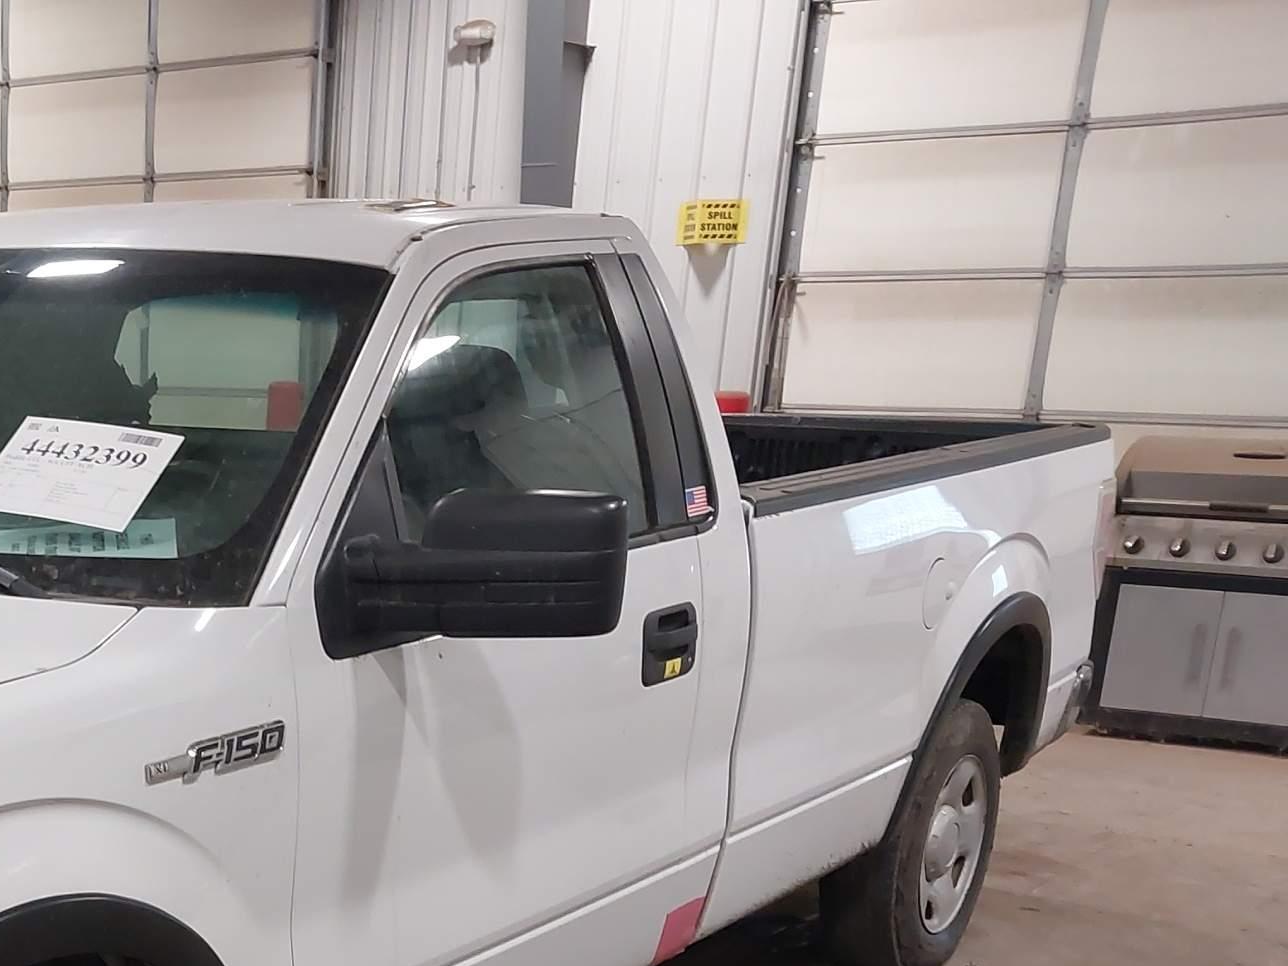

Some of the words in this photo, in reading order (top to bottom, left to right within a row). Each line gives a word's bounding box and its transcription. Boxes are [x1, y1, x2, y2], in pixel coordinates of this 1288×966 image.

[707, 211, 733, 220] SPILL
[700, 222, 738, 231] STATION
[20, 438, 148, 469] 44432399
